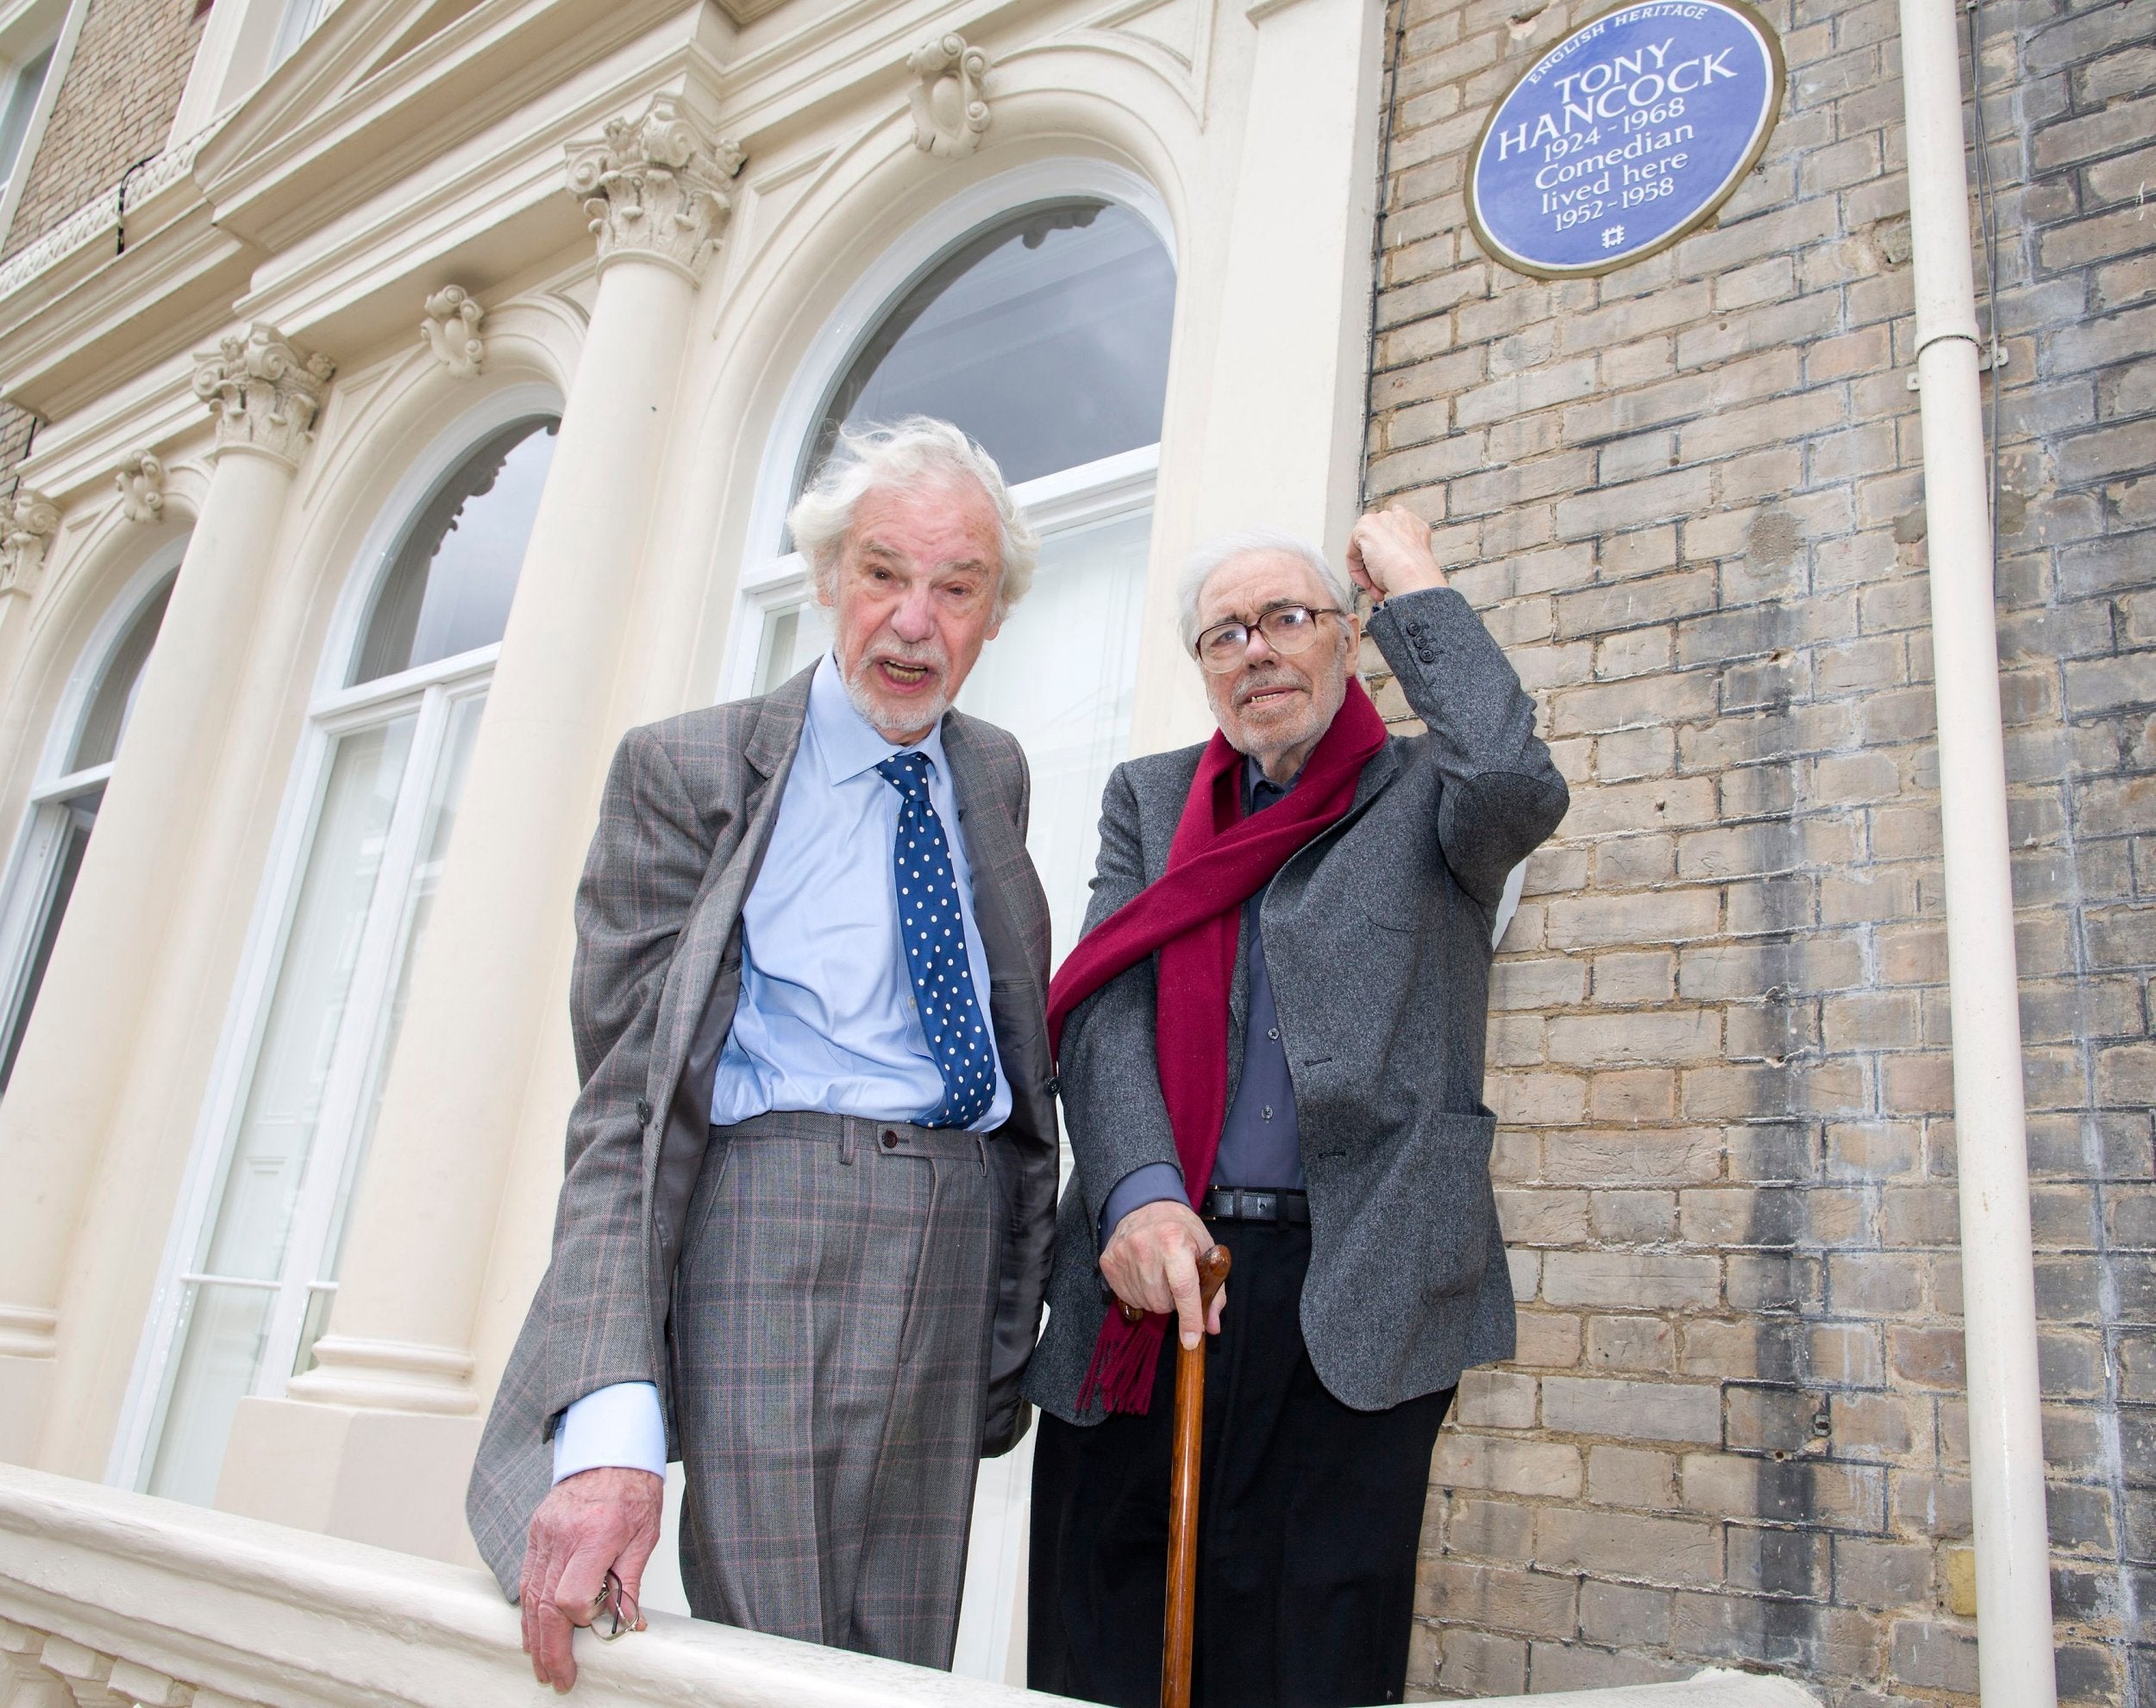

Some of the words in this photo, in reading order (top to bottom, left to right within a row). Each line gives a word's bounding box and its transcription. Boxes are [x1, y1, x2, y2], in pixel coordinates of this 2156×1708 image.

[1529, 23, 1605, 84] ENGLISH
[1614, 5, 1708, 28] HERITAGE
[1554, 38, 1675, 103] TONY
[1497, 47, 1738, 161] HANCOCK
[1535, 124, 1695, 190] Comedian
[1542, 172, 1610, 215] lived
[1623, 153, 1689, 186] here
